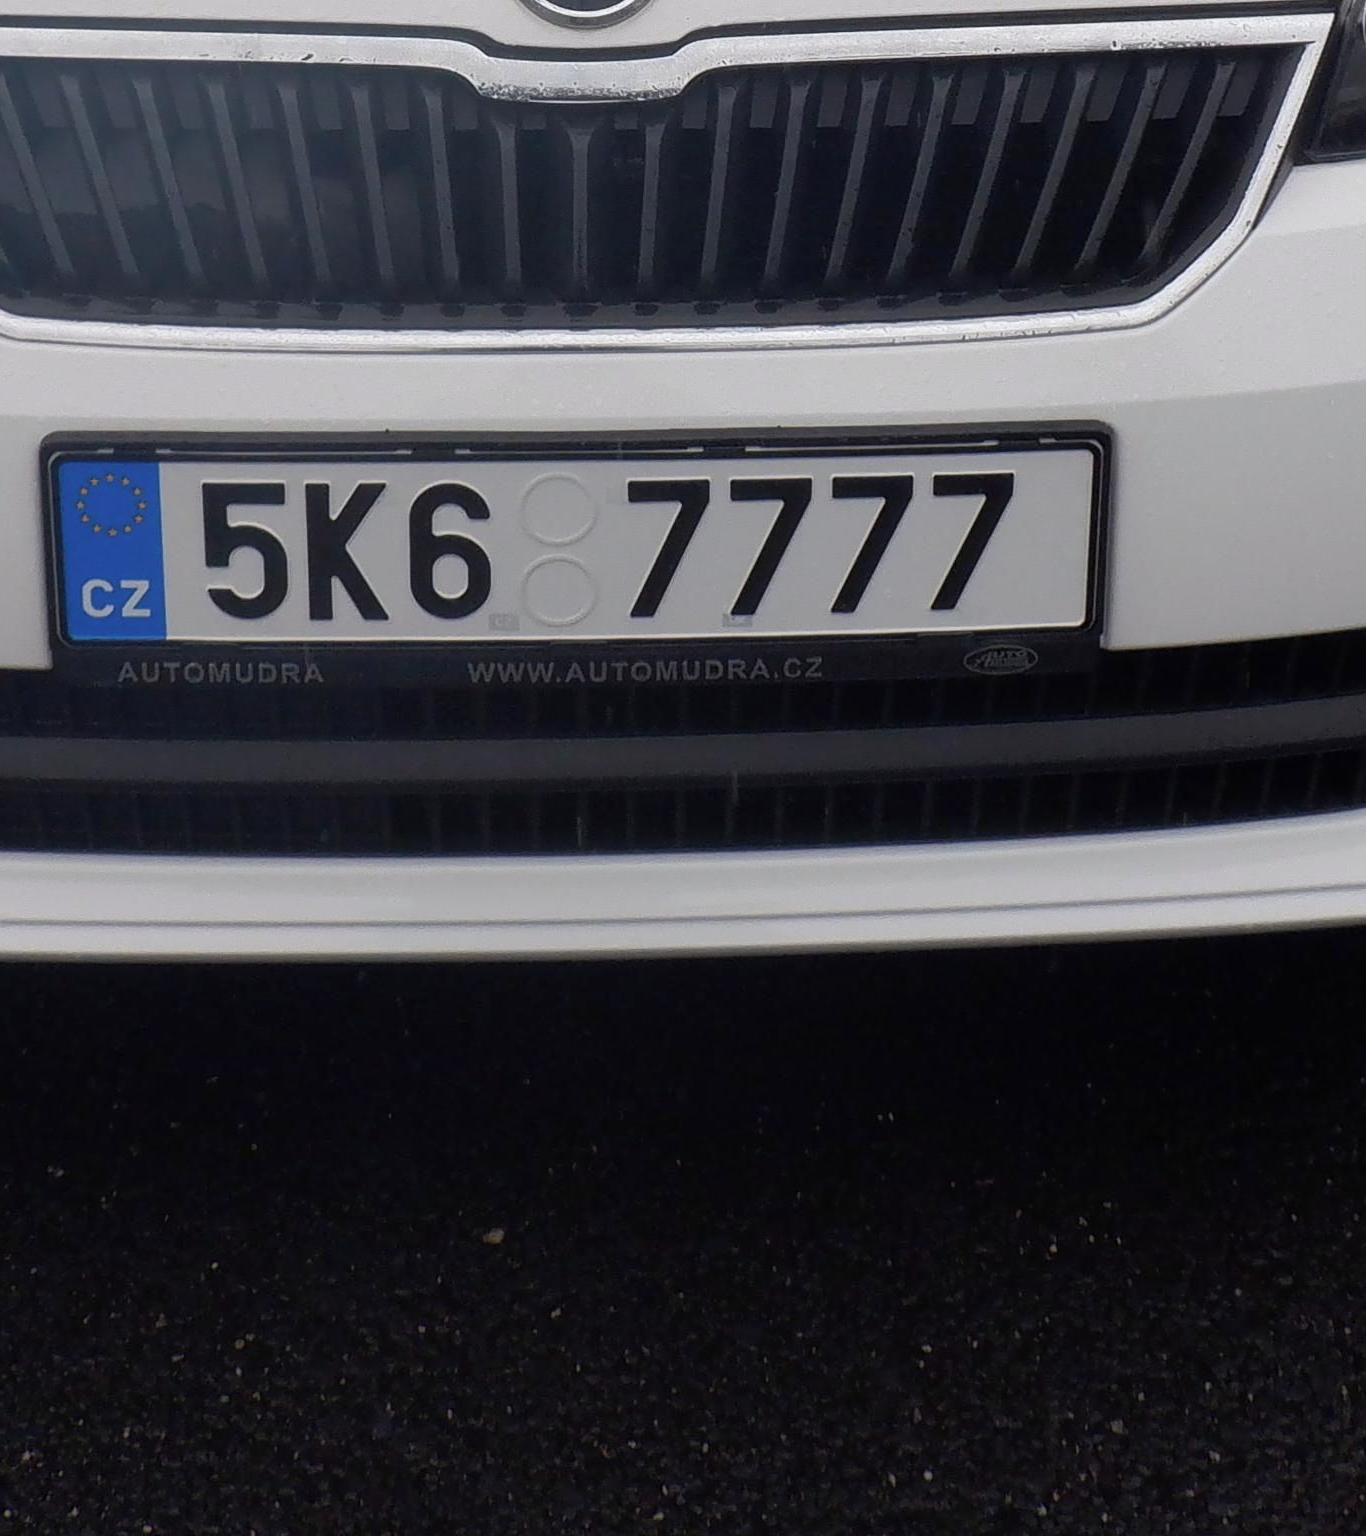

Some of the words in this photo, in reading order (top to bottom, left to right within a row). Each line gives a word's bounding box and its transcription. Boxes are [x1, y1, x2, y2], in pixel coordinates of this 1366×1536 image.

[81, 578, 152, 618] CZ
[201, 480, 492, 622] 5K6
[627, 471, 1016, 619] 7777
[117, 661, 325, 685] AUTOMUDRA
[467, 655, 824, 685] WWW.AUTOMUDRA.CZ
